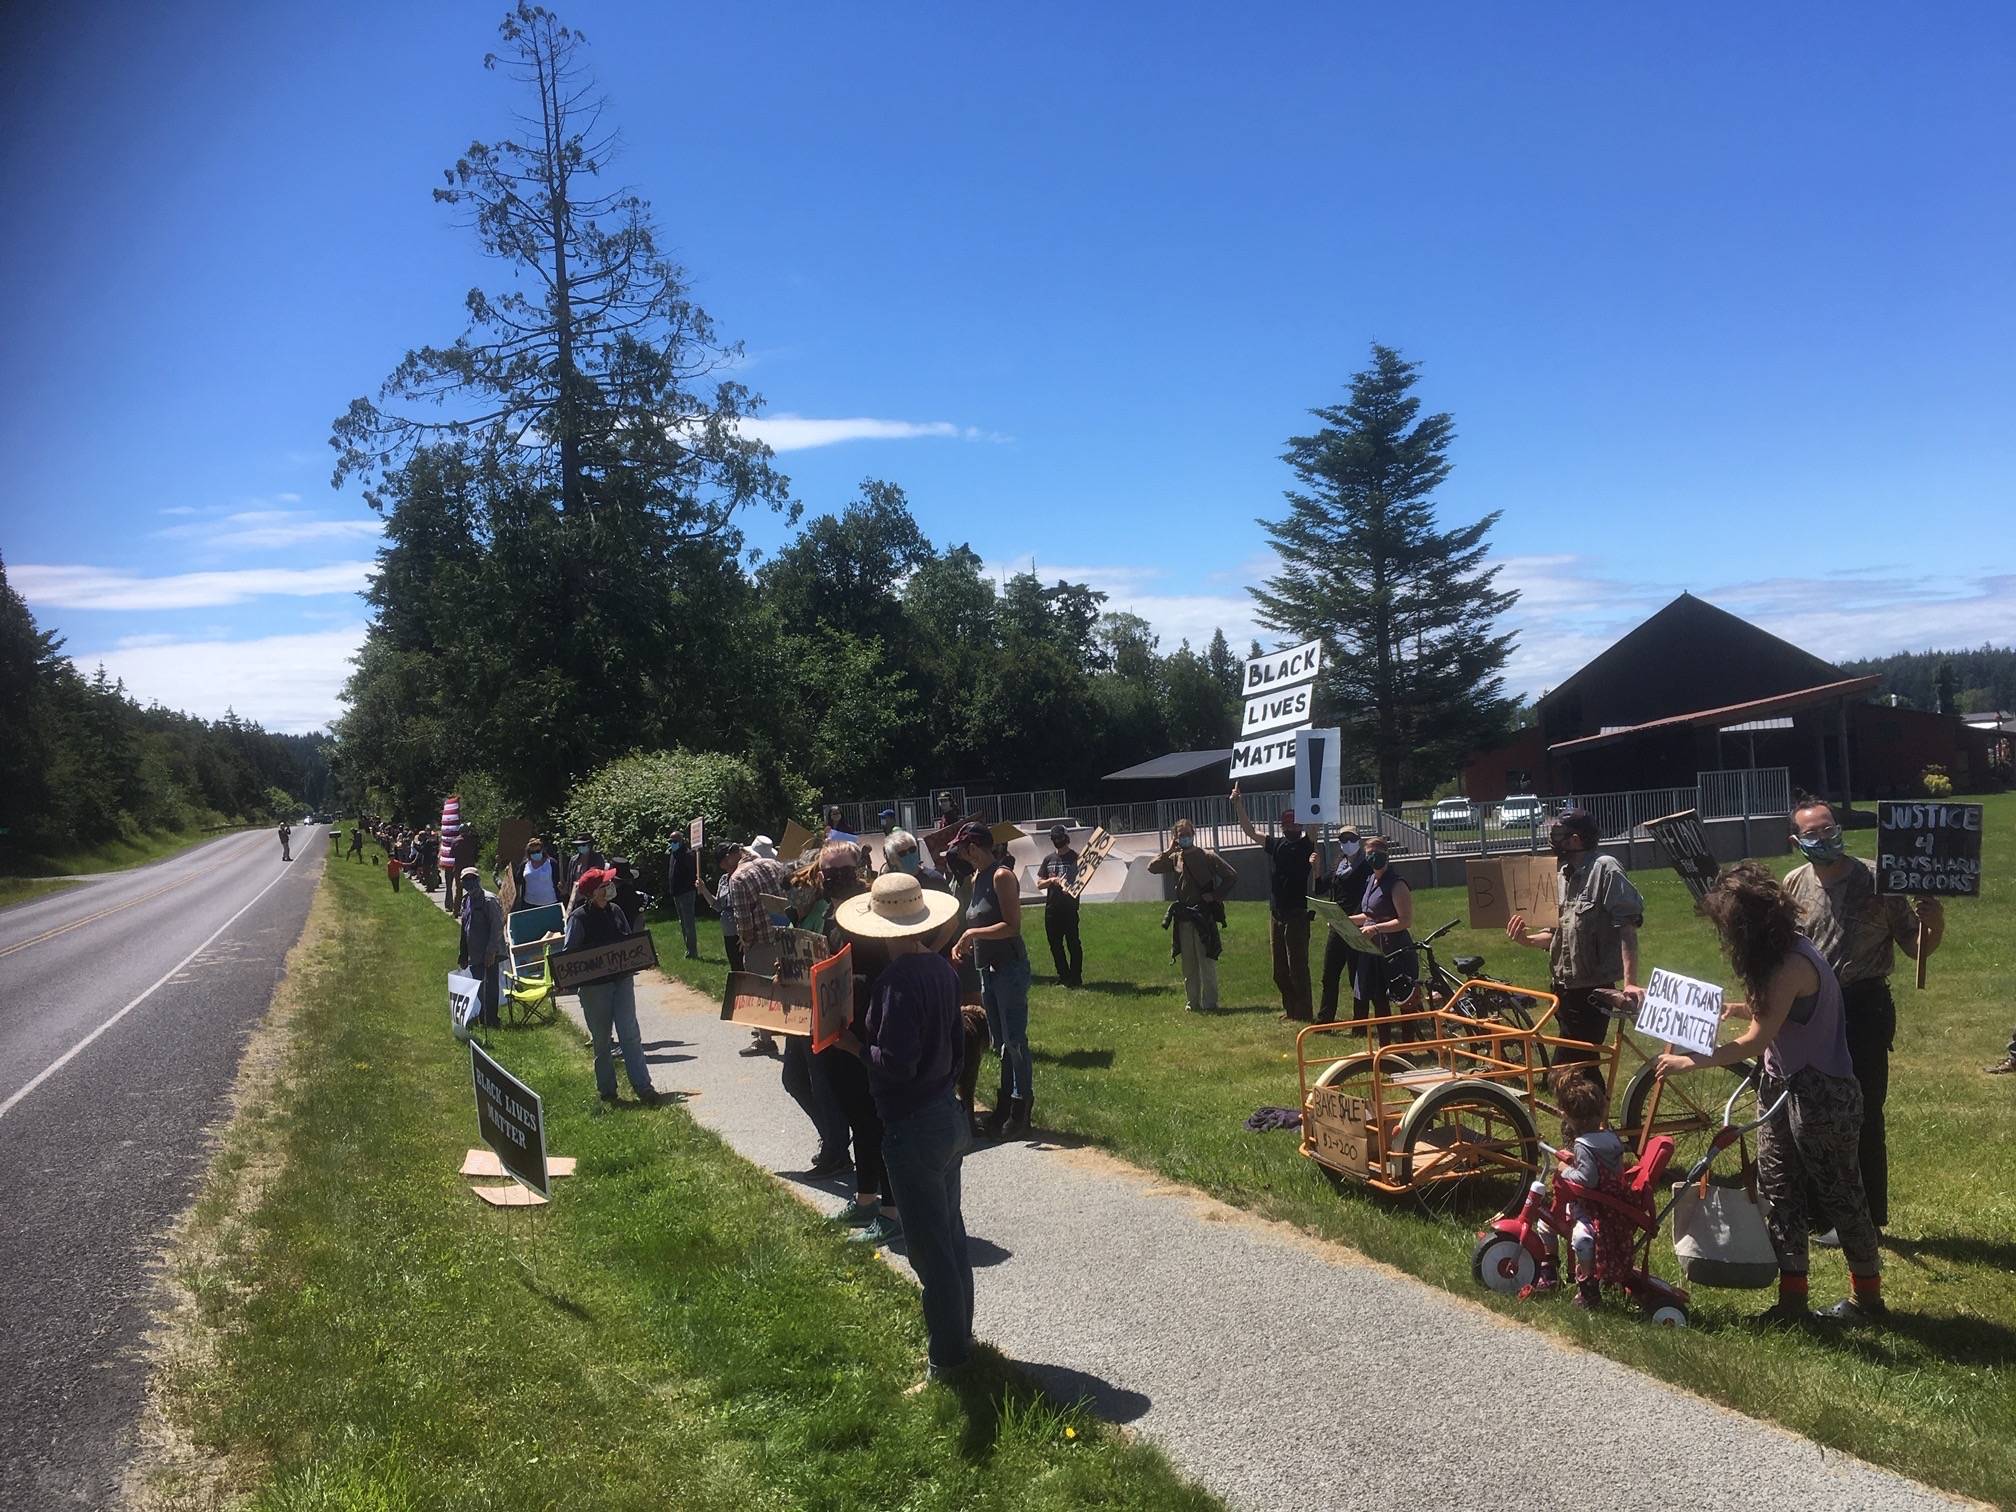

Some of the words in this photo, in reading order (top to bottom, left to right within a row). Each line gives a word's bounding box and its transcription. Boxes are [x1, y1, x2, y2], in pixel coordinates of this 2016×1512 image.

[1248, 647, 1317, 688] BLACK
[1247, 692, 1307, 725] LIVES
[1231, 739, 1297, 770] MATTE
[1881, 804, 1980, 831] JUSTICE
[1091, 830, 1111, 850] NO
[1915, 832, 1935, 855] 4
[1881, 853, 1980, 874] RAYSHARD
[1888, 870, 1975, 892] BROOKS
[605, 944, 648, 969] TAYLOR
[1647, 970, 1684, 1006] BLACK
[1685, 982, 1721, 1015] TRANS
[1637, 1002, 1671, 1034] LIVES
[1669, 1010, 1716, 1048] MATTER
[475, 1068, 503, 1106] BLACK
[504, 1095, 537, 1133] LIVES
[1314, 1087, 1338, 1118] BAKE
[487, 1103, 527, 1150] MATTER
